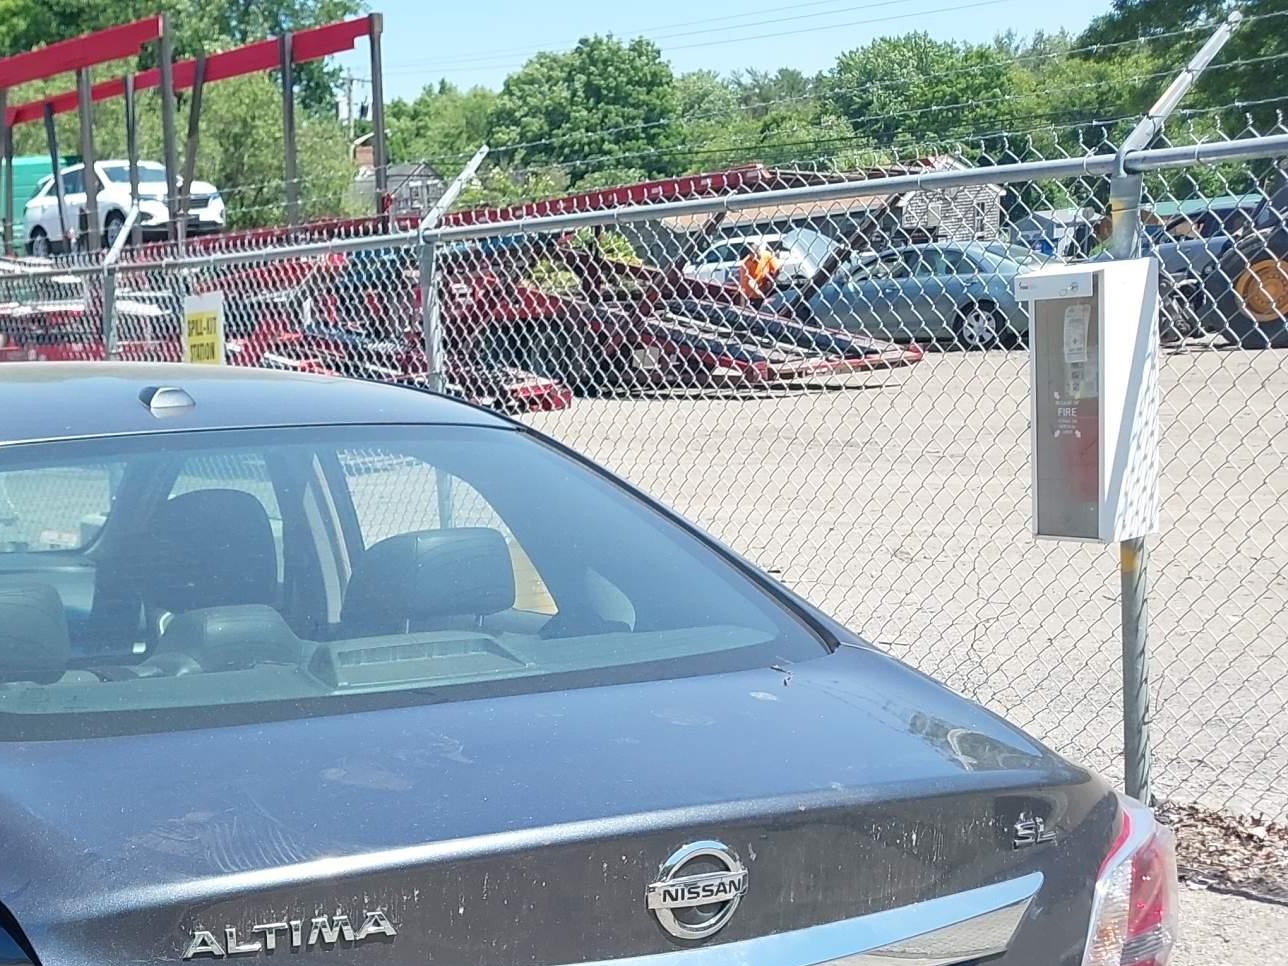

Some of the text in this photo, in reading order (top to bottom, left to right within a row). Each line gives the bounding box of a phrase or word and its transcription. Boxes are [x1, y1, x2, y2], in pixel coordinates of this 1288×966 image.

[1057, 407, 1078, 417] FIRE
[662, 878, 742, 903] NISSAN
[183, 911, 398, 961] ALTIMA
